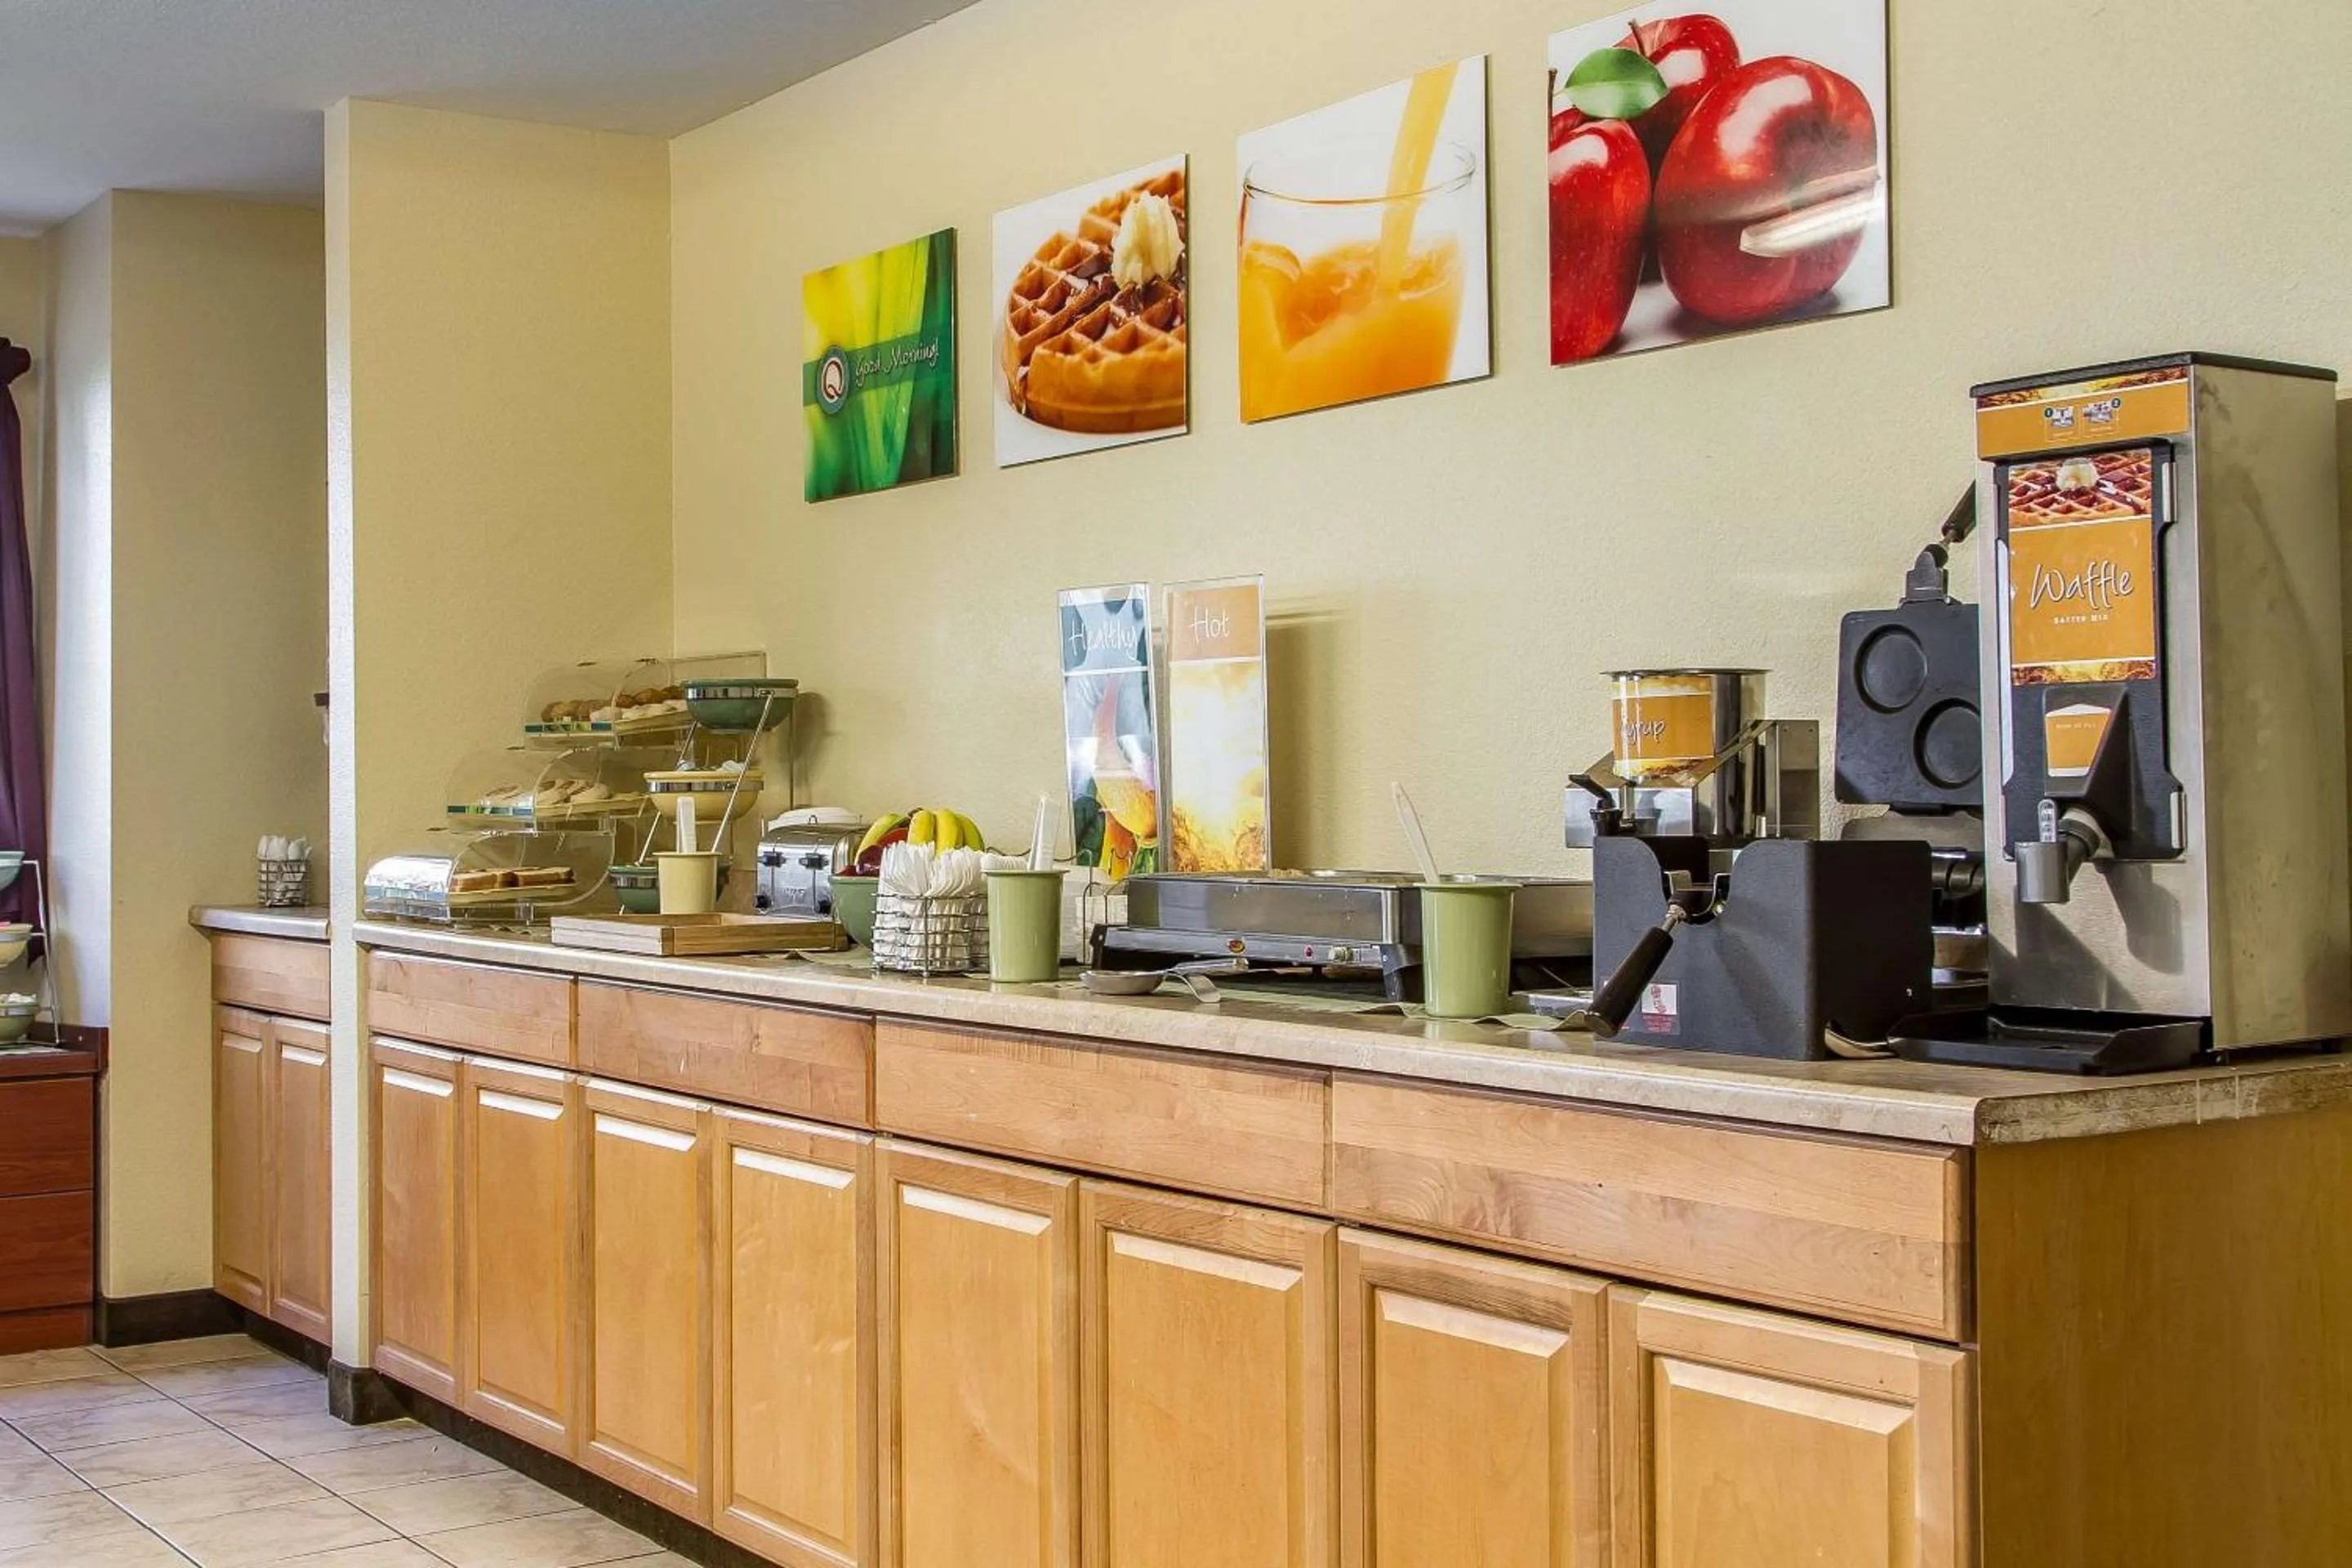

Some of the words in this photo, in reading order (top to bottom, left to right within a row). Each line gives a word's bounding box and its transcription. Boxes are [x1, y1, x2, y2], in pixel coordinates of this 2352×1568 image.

[823, 359, 842, 399] Q
[855, 352, 880, 386] Good
[2030, 560, 2134, 609] Waffle
[1069, 618, 1138, 662] Healthy
[1189, 607, 1230, 644] Hot
